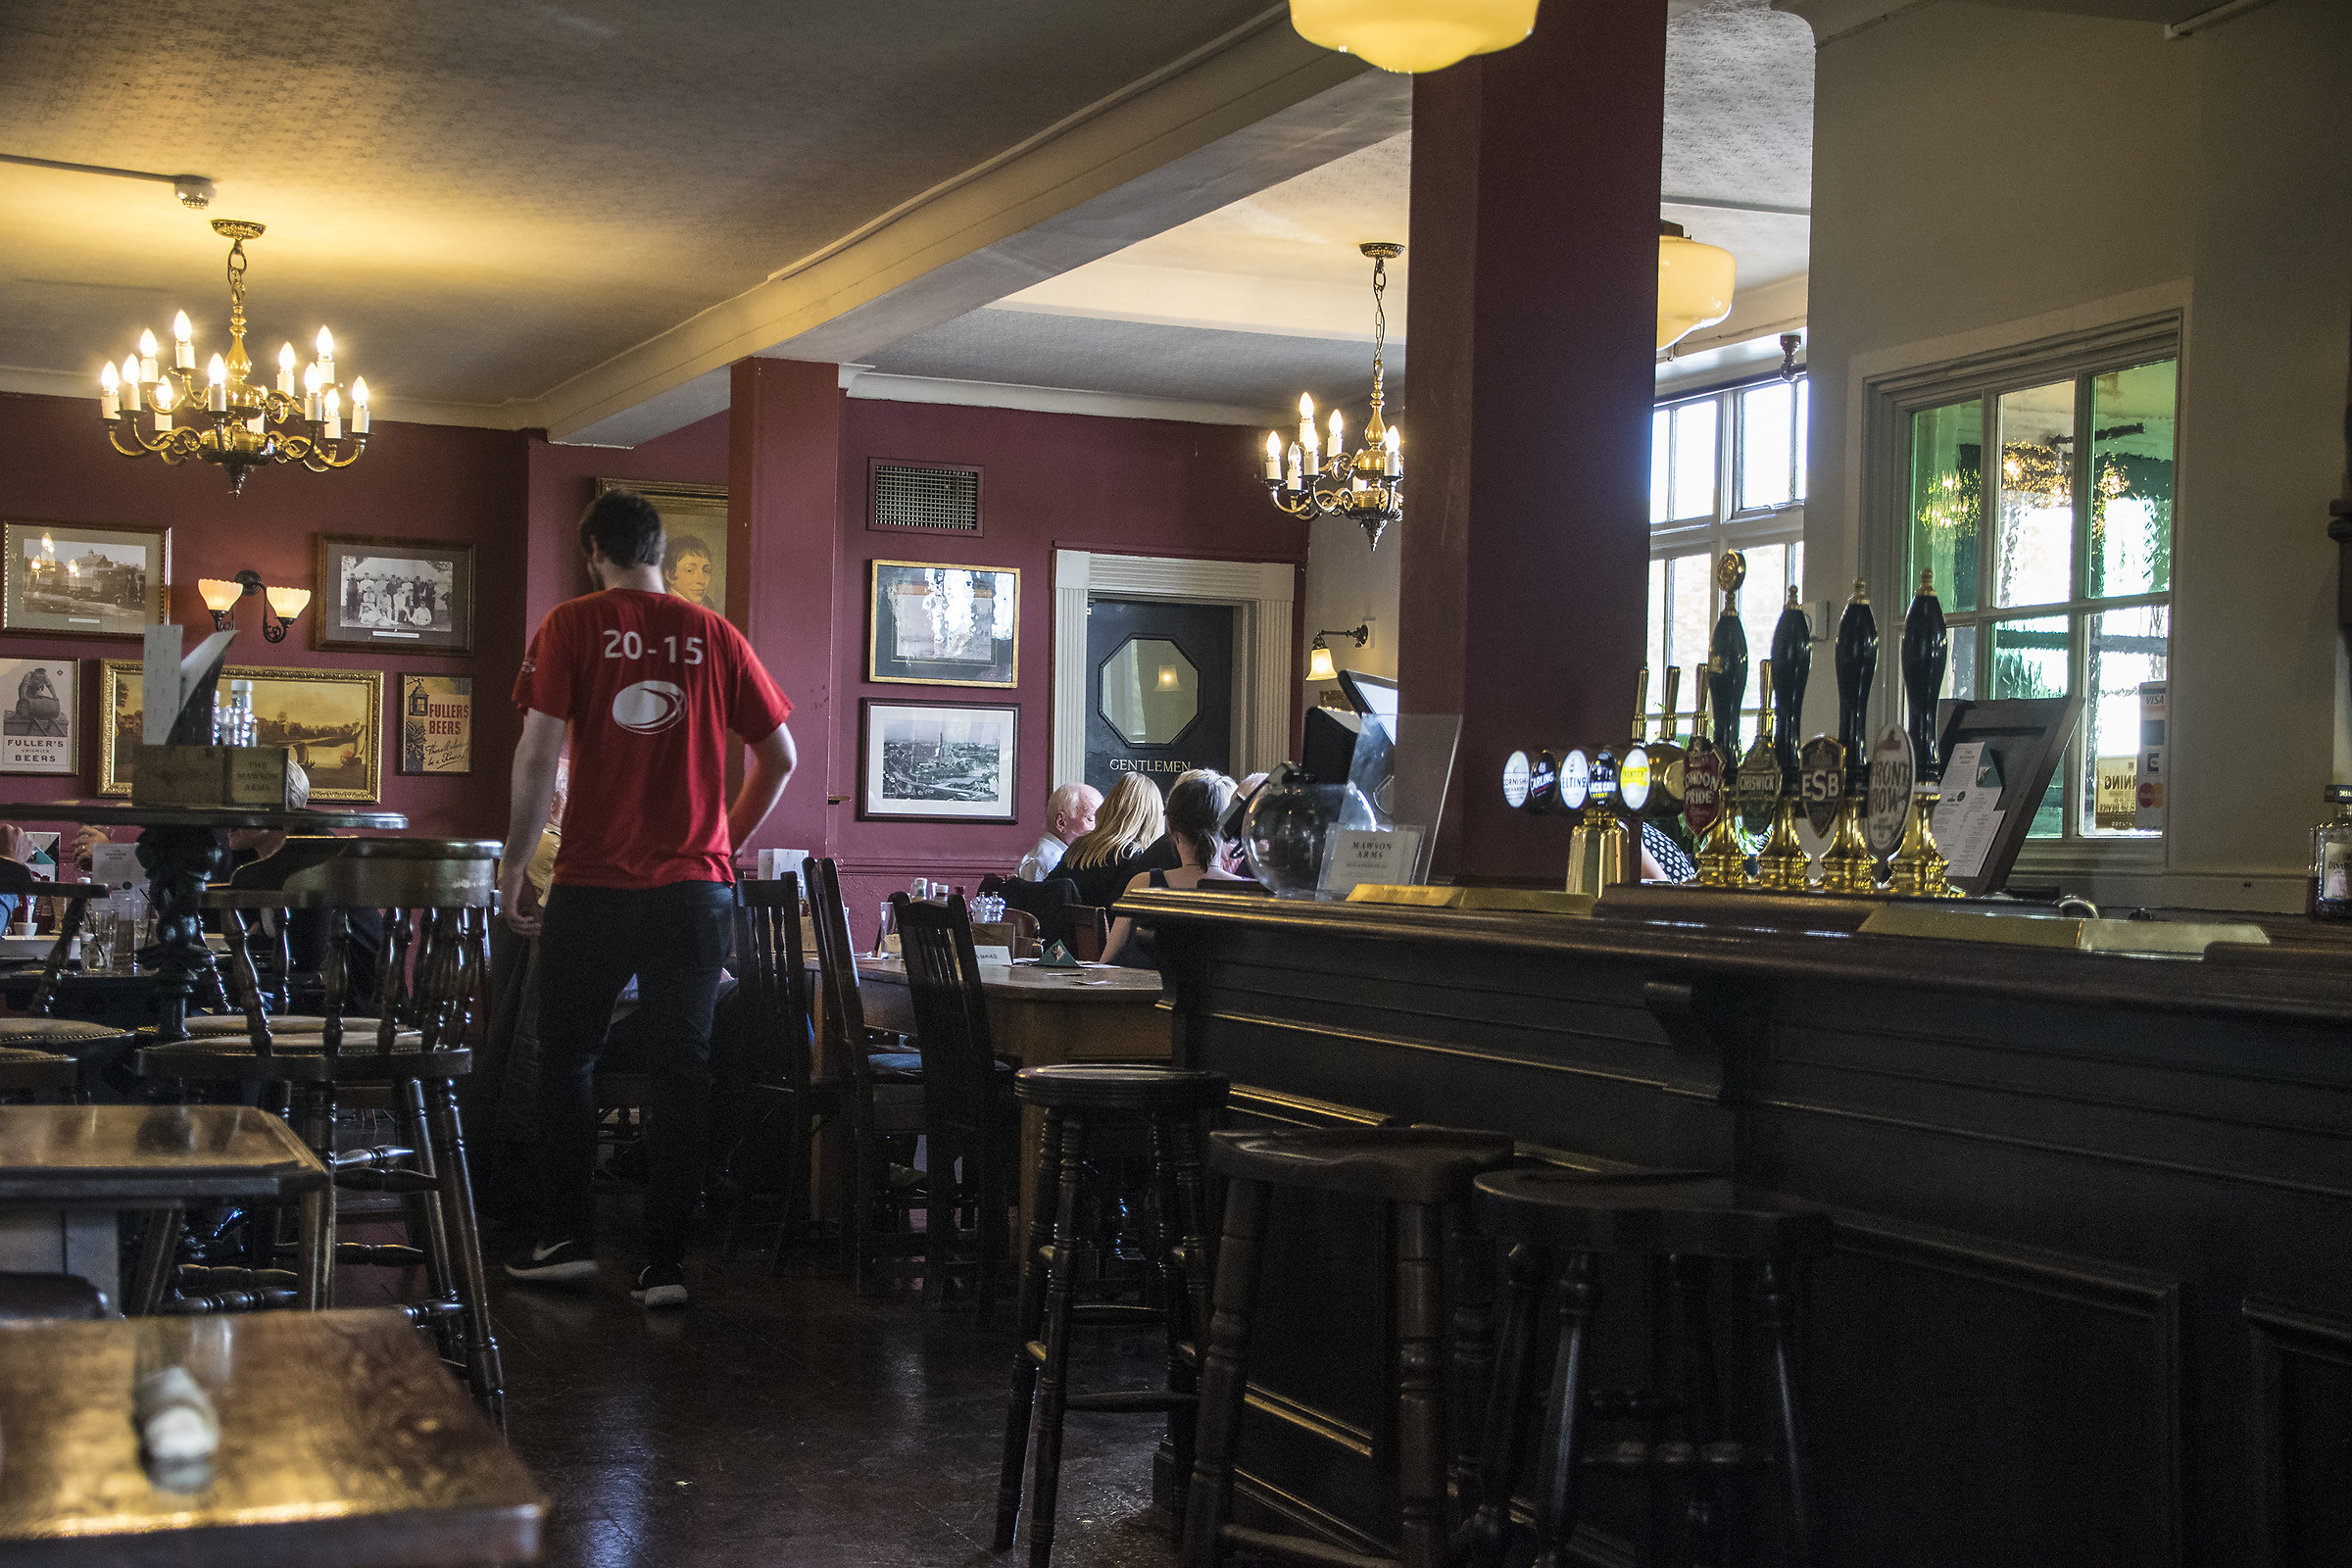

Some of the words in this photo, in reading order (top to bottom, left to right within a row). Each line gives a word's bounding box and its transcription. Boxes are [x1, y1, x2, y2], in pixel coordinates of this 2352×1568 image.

[603, 629, 704, 665] 20-15
[2146, 695, 2165, 705] VISA
[428, 720, 462, 735] BEERS
[7, 739, 64, 748] FULLER'S
[1108, 758, 1192, 773] GENTLEMEN
[1685, 769, 1720, 791] ONDON
[1801, 769, 1839, 802] ESB
[1686, 789, 1713, 805] PRIDE
[1351, 842, 1393, 851] MAWSON
[1357, 851, 1384, 859] ARMS
